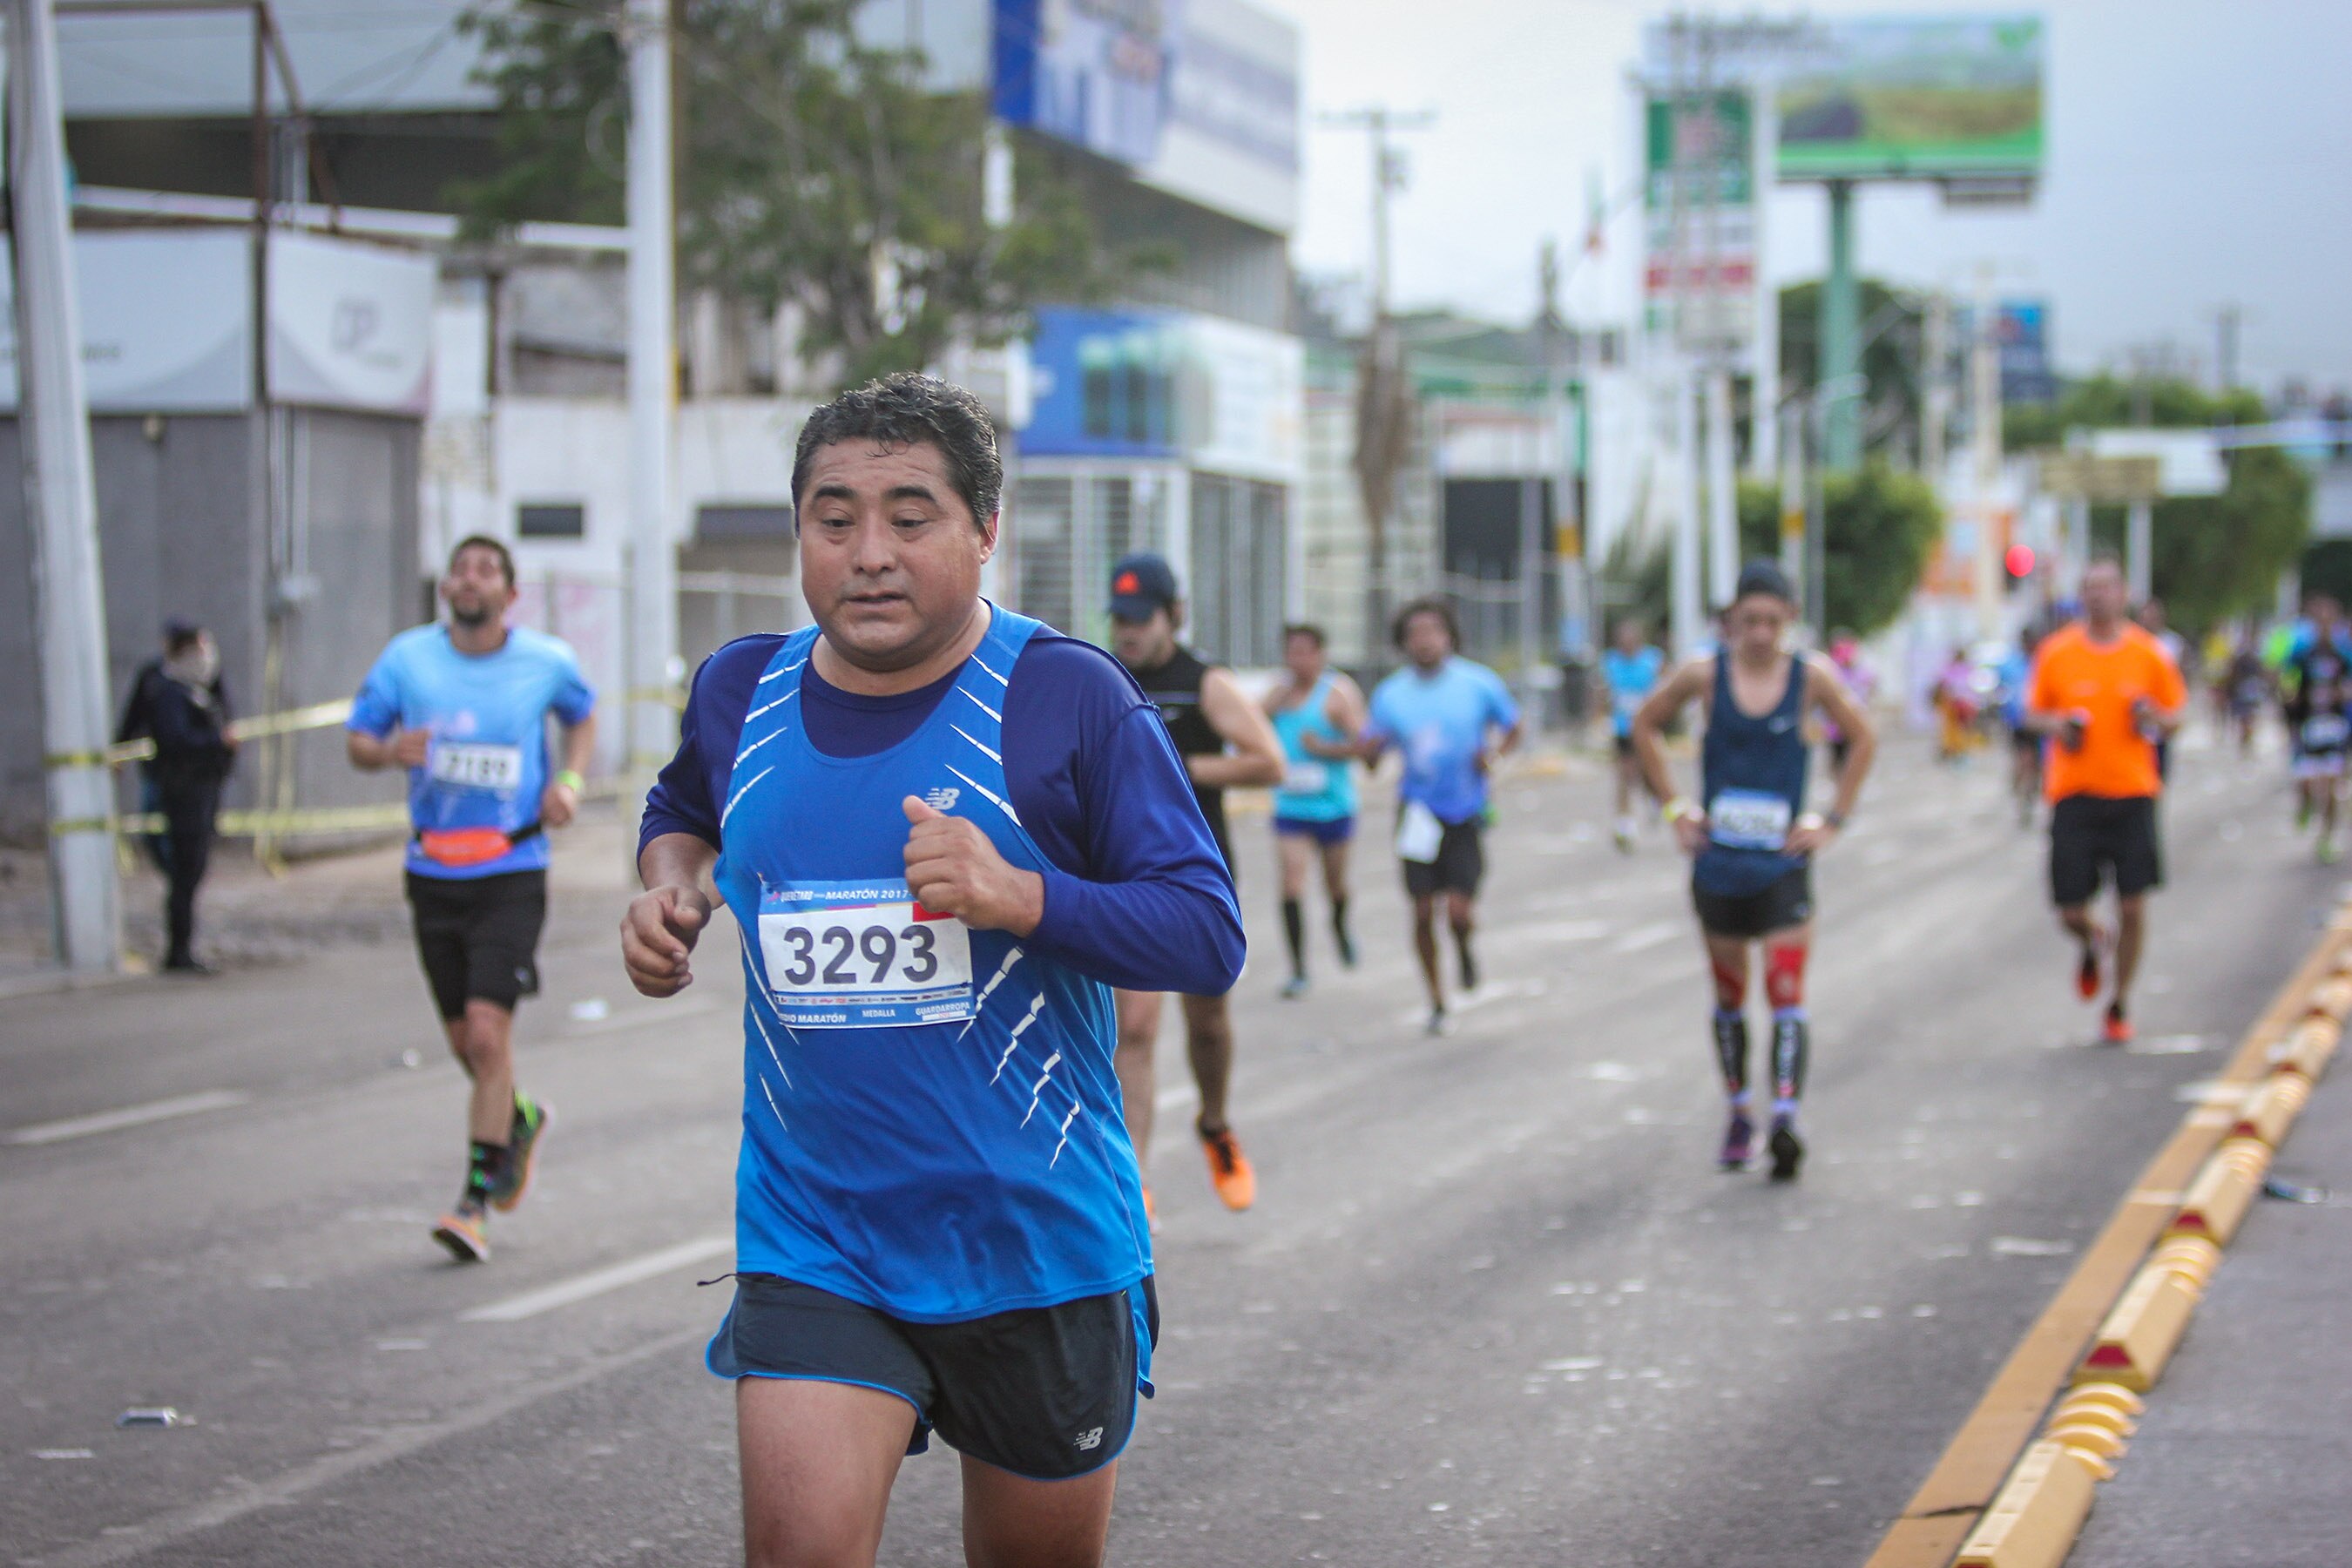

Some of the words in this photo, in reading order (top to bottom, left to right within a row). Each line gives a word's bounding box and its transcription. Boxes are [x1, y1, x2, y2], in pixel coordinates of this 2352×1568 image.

[825, 889, 878, 900] MARATÓN
[881, 890, 909, 899] 2017
[783, 924, 937, 985] 3293
[862, 1009, 896, 1018] MEDALLA
[915, 1002, 971, 1017] GUARDARROPA
[797, 1012, 848, 1024] MARATÓN
